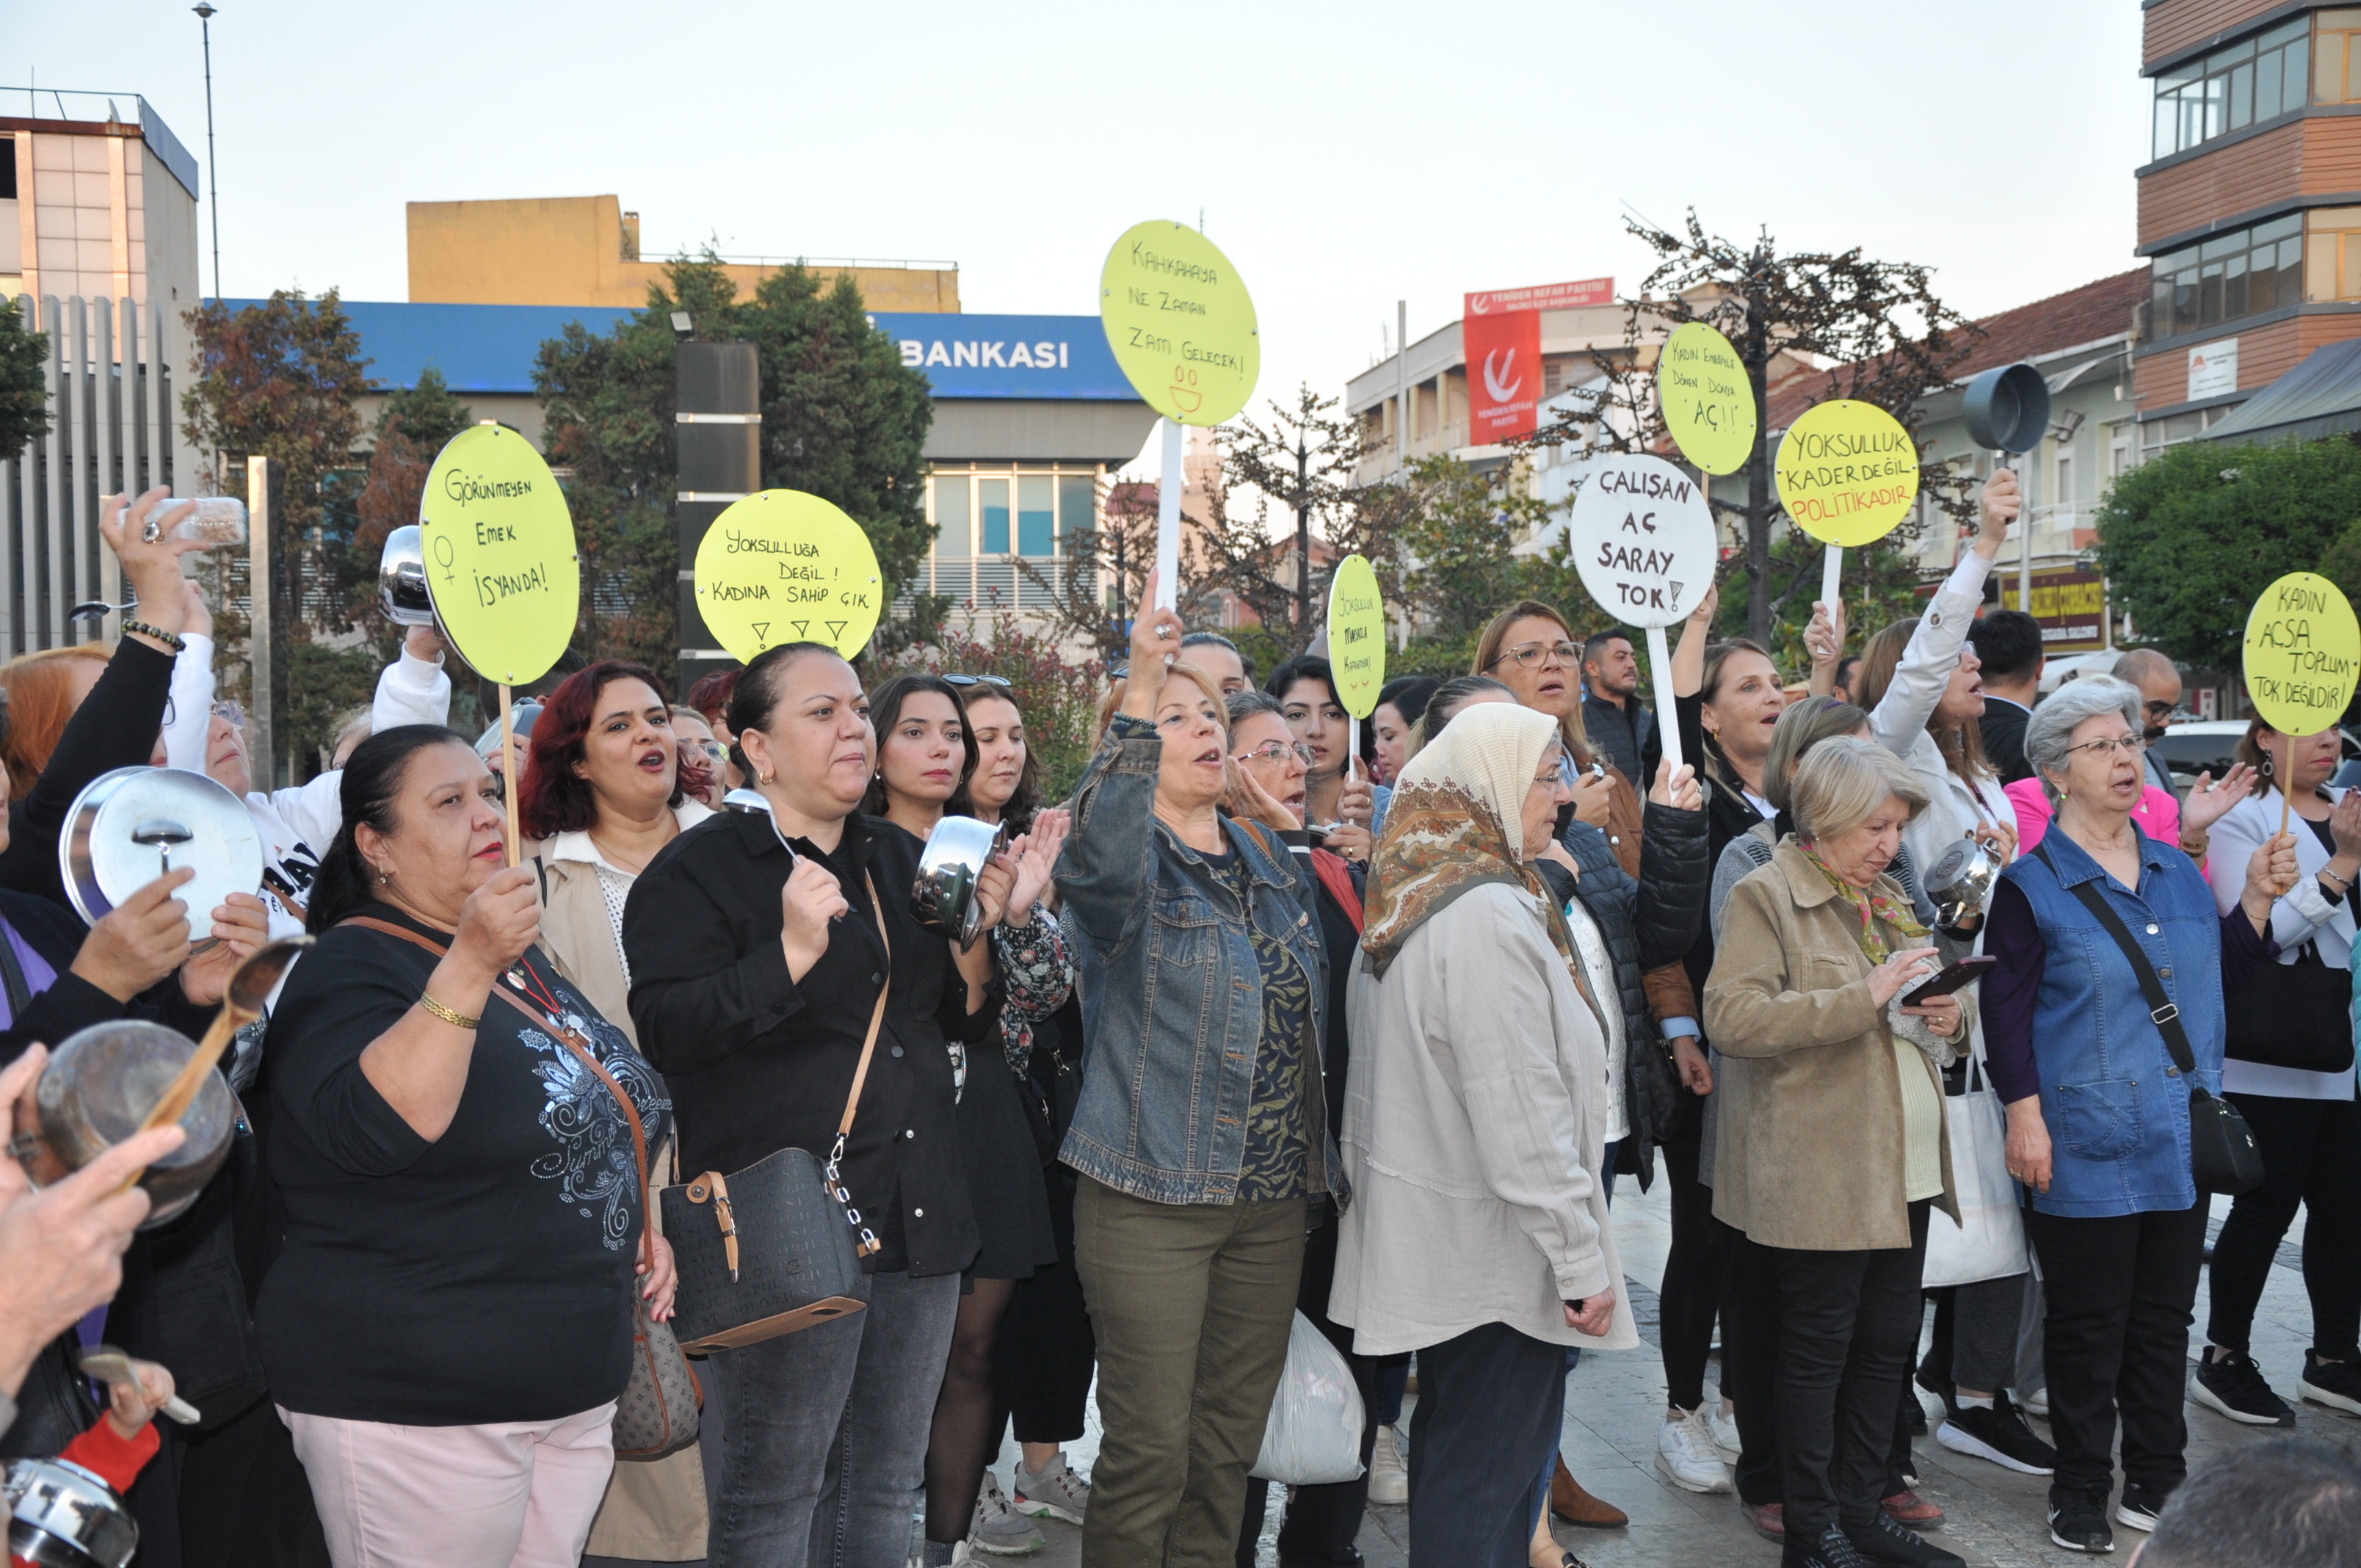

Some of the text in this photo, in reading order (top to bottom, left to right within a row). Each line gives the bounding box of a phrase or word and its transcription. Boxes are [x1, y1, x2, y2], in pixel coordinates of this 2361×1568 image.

[1131, 240, 1217, 285] KAHKAHAYA
[1128, 286, 1206, 316] NE ZAMAN
[899, 339, 1068, 369] BANKASI
[1129, 327, 1244, 380] ZAM GELECEK!
[1672, 341, 1698, 362] KADIN
[1672, 369, 1698, 388] DÖNEN
[1790, 431, 1908, 462] YOKSULLUK
[445, 468, 532, 507] GÖRÜNMEYEN
[1600, 471, 1691, 504] ÇALIŞAN
[1786, 457, 1911, 492] KADER DEĞİL
[1792, 484, 1912, 527] POLİTİKADIR
[476, 522, 517, 545] EMEK
[1621, 512, 1656, 534] AÇ
[726, 529, 819, 558] YOKSULLUĞA
[1597, 542, 1675, 576] SARAY
[473, 562, 548, 608] İSYANDA!
[712, 581, 869, 609] KADINA SAHİP ÇIK
[2277, 585, 2326, 614] KADIN
[1338, 588, 1374, 617] YOKSULLUK
[2288, 650, 2350, 678] TOPLUM
[2254, 676, 2346, 710] TOK DEĞİLDİR!
